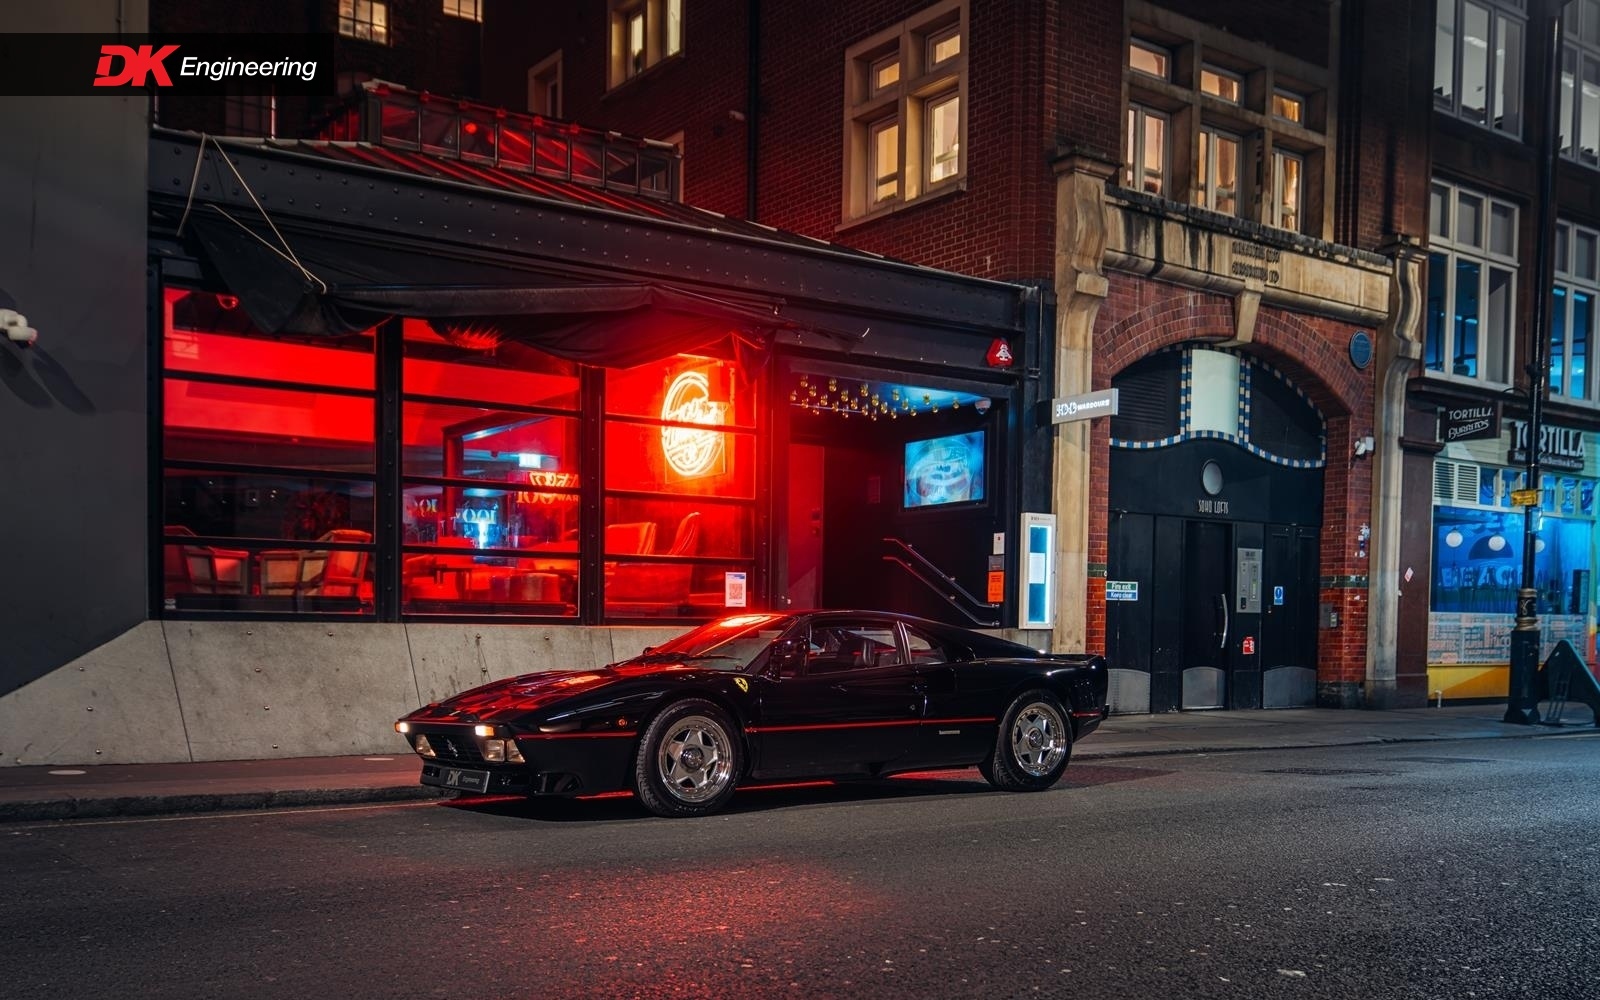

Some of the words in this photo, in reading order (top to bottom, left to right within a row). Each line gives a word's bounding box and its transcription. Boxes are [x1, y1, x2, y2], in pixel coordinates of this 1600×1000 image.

[1449, 407, 1494, 420] TORTILLA
[1449, 420, 1489, 439] BURRITOS
[1199, 500, 1213, 513] SOHO
[1214, 501, 1229, 514] LOFTS
